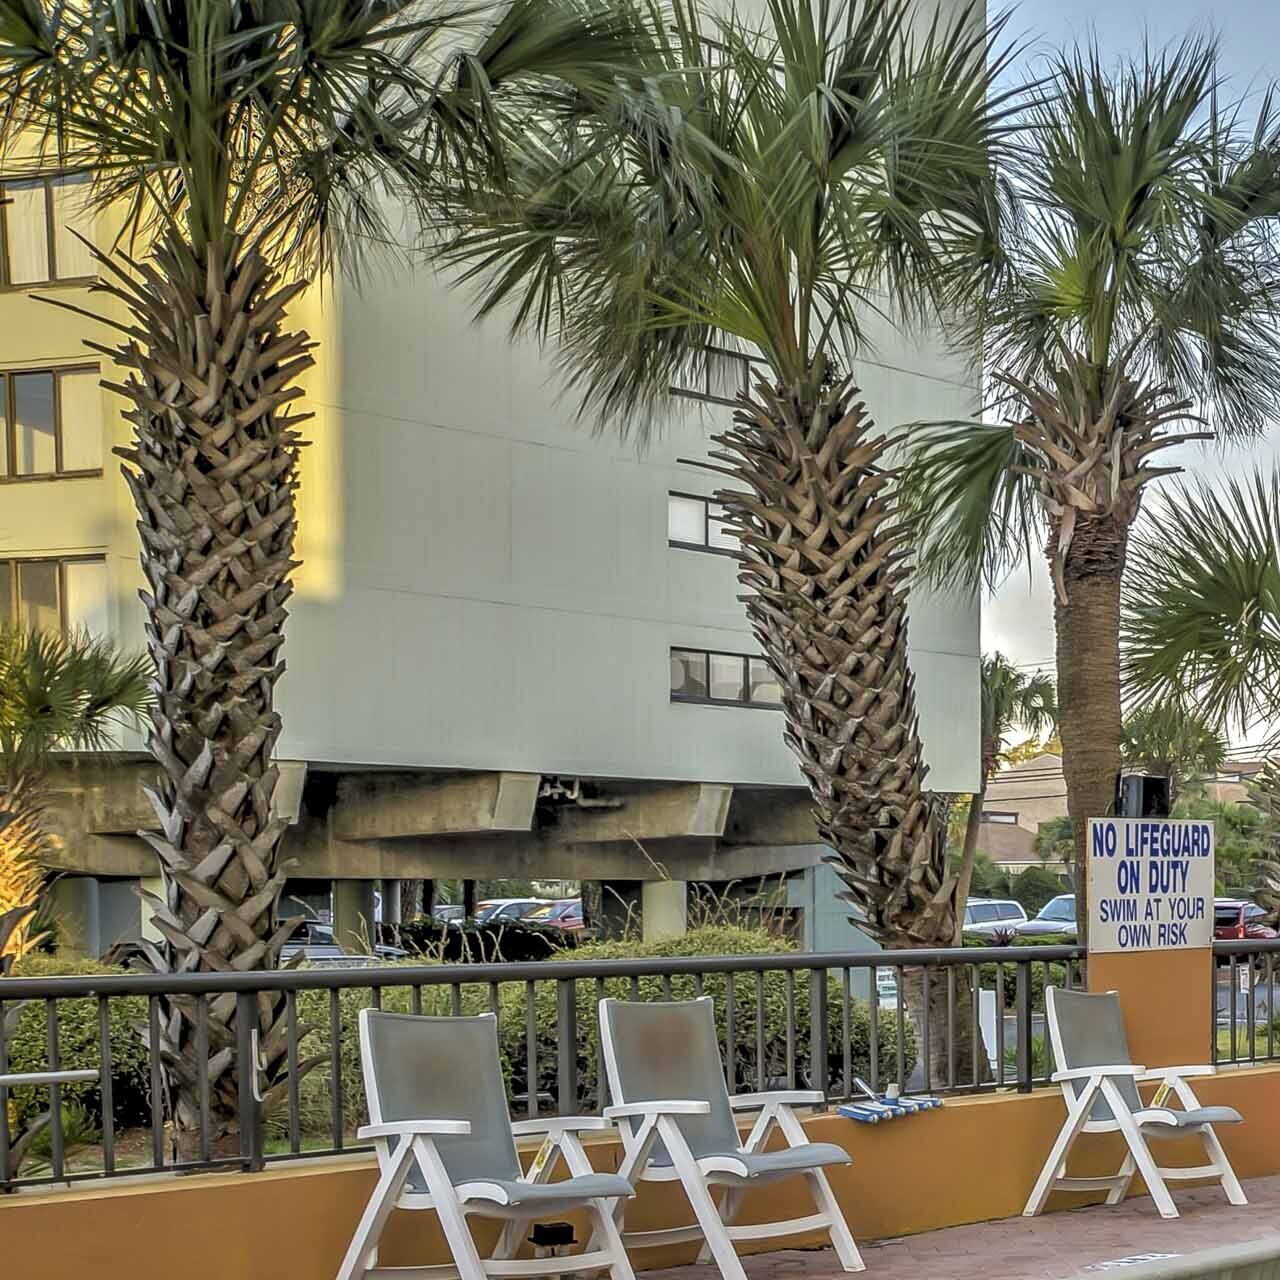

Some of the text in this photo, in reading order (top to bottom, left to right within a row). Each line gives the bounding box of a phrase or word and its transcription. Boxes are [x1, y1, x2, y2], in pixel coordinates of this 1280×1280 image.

[1092, 822, 1211, 857] NO LIFEGUARD
[1117, 860, 1190, 894] ON DUTY
[1100, 897, 1204, 922] SWIM AT YOUR
[1118, 922, 1188, 947] OWN RISK
